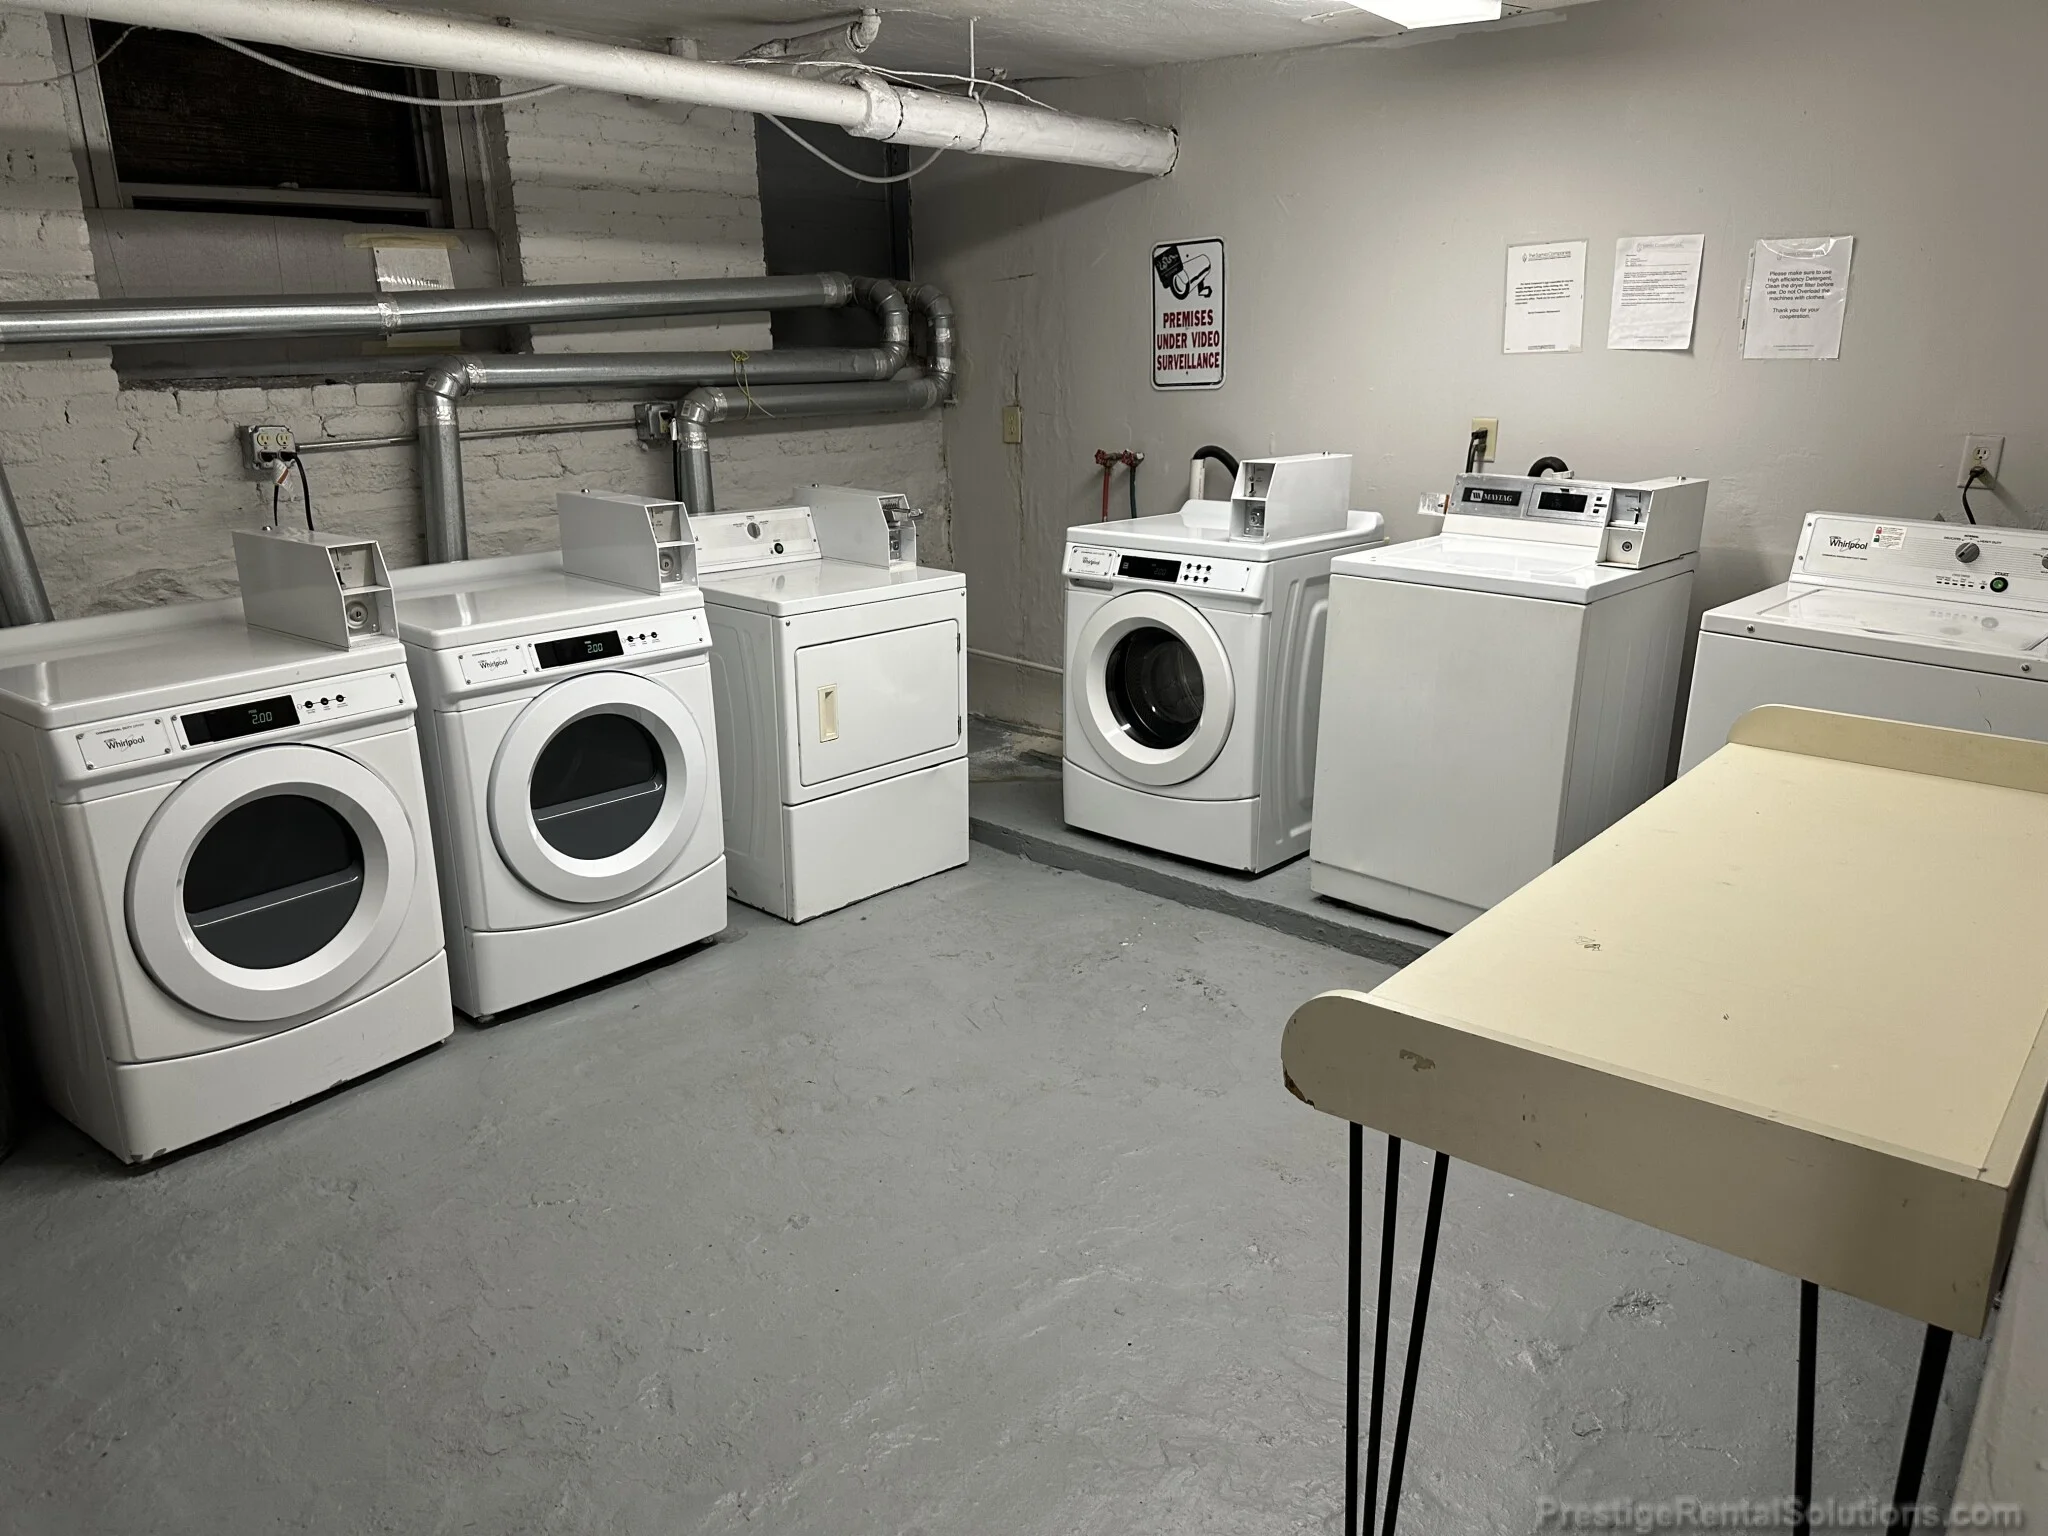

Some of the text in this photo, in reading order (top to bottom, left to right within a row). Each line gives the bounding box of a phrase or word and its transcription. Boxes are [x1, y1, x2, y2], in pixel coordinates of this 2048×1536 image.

[1163, 309, 1213, 328] PREMISES
[1157, 330, 1219, 350] UNDER VIDEO
[1157, 352, 1220, 371] SURVEILLANCE
[1482, 492, 1513, 502] MAYTAG
[1829, 538, 1868, 550] Whirlpool
[479, 658, 508, 669] Whirlpool
[252, 711, 273, 725] 2.00
[104, 735, 145, 750] Whirlpool
